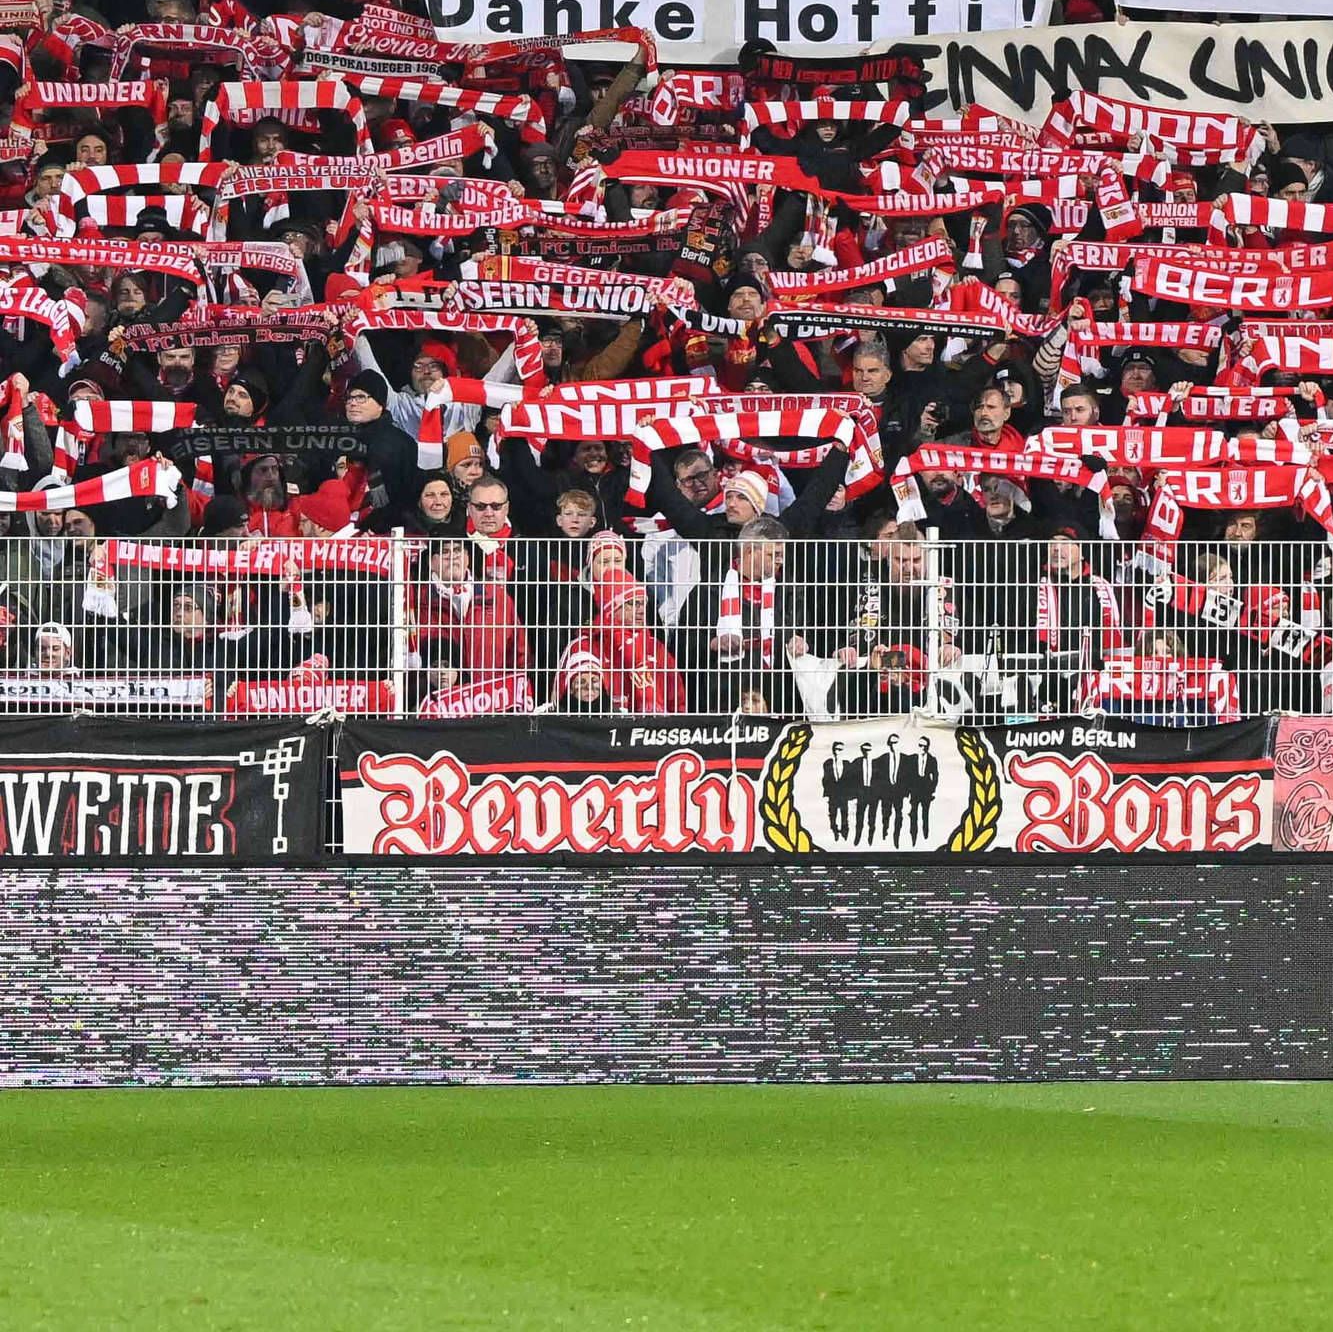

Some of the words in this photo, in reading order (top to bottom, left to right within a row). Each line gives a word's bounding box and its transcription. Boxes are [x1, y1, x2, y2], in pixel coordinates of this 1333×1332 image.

[40, 82, 145, 101] UNIONER
[398, 138, 463, 166] Berlin
[658, 153, 776, 183] UNIONER
[879, 192, 984, 212] UNIONER
[1151, 204, 1198, 217] UNION
[381, 211, 418, 230] FÜR
[421, 204, 530, 228] MITGLIEDER!
[20, 243, 63, 260] FÜR
[209, 252, 240, 268] ROT
[243, 253, 295, 271] WEISS
[770, 271, 809, 290] NUR
[812, 265, 857, 285] FÜR
[920, 451, 1079, 475] UNIONER
[609, 729, 623, 747] 1.
[629, 726, 769, 748] FUSSBALLCLUB
[1005, 730, 1065, 747] UNION
[1072, 730, 1136, 748] BERLIN
[356, 750, 758, 854] Beverly
[1008, 753, 1260, 852] Boys
